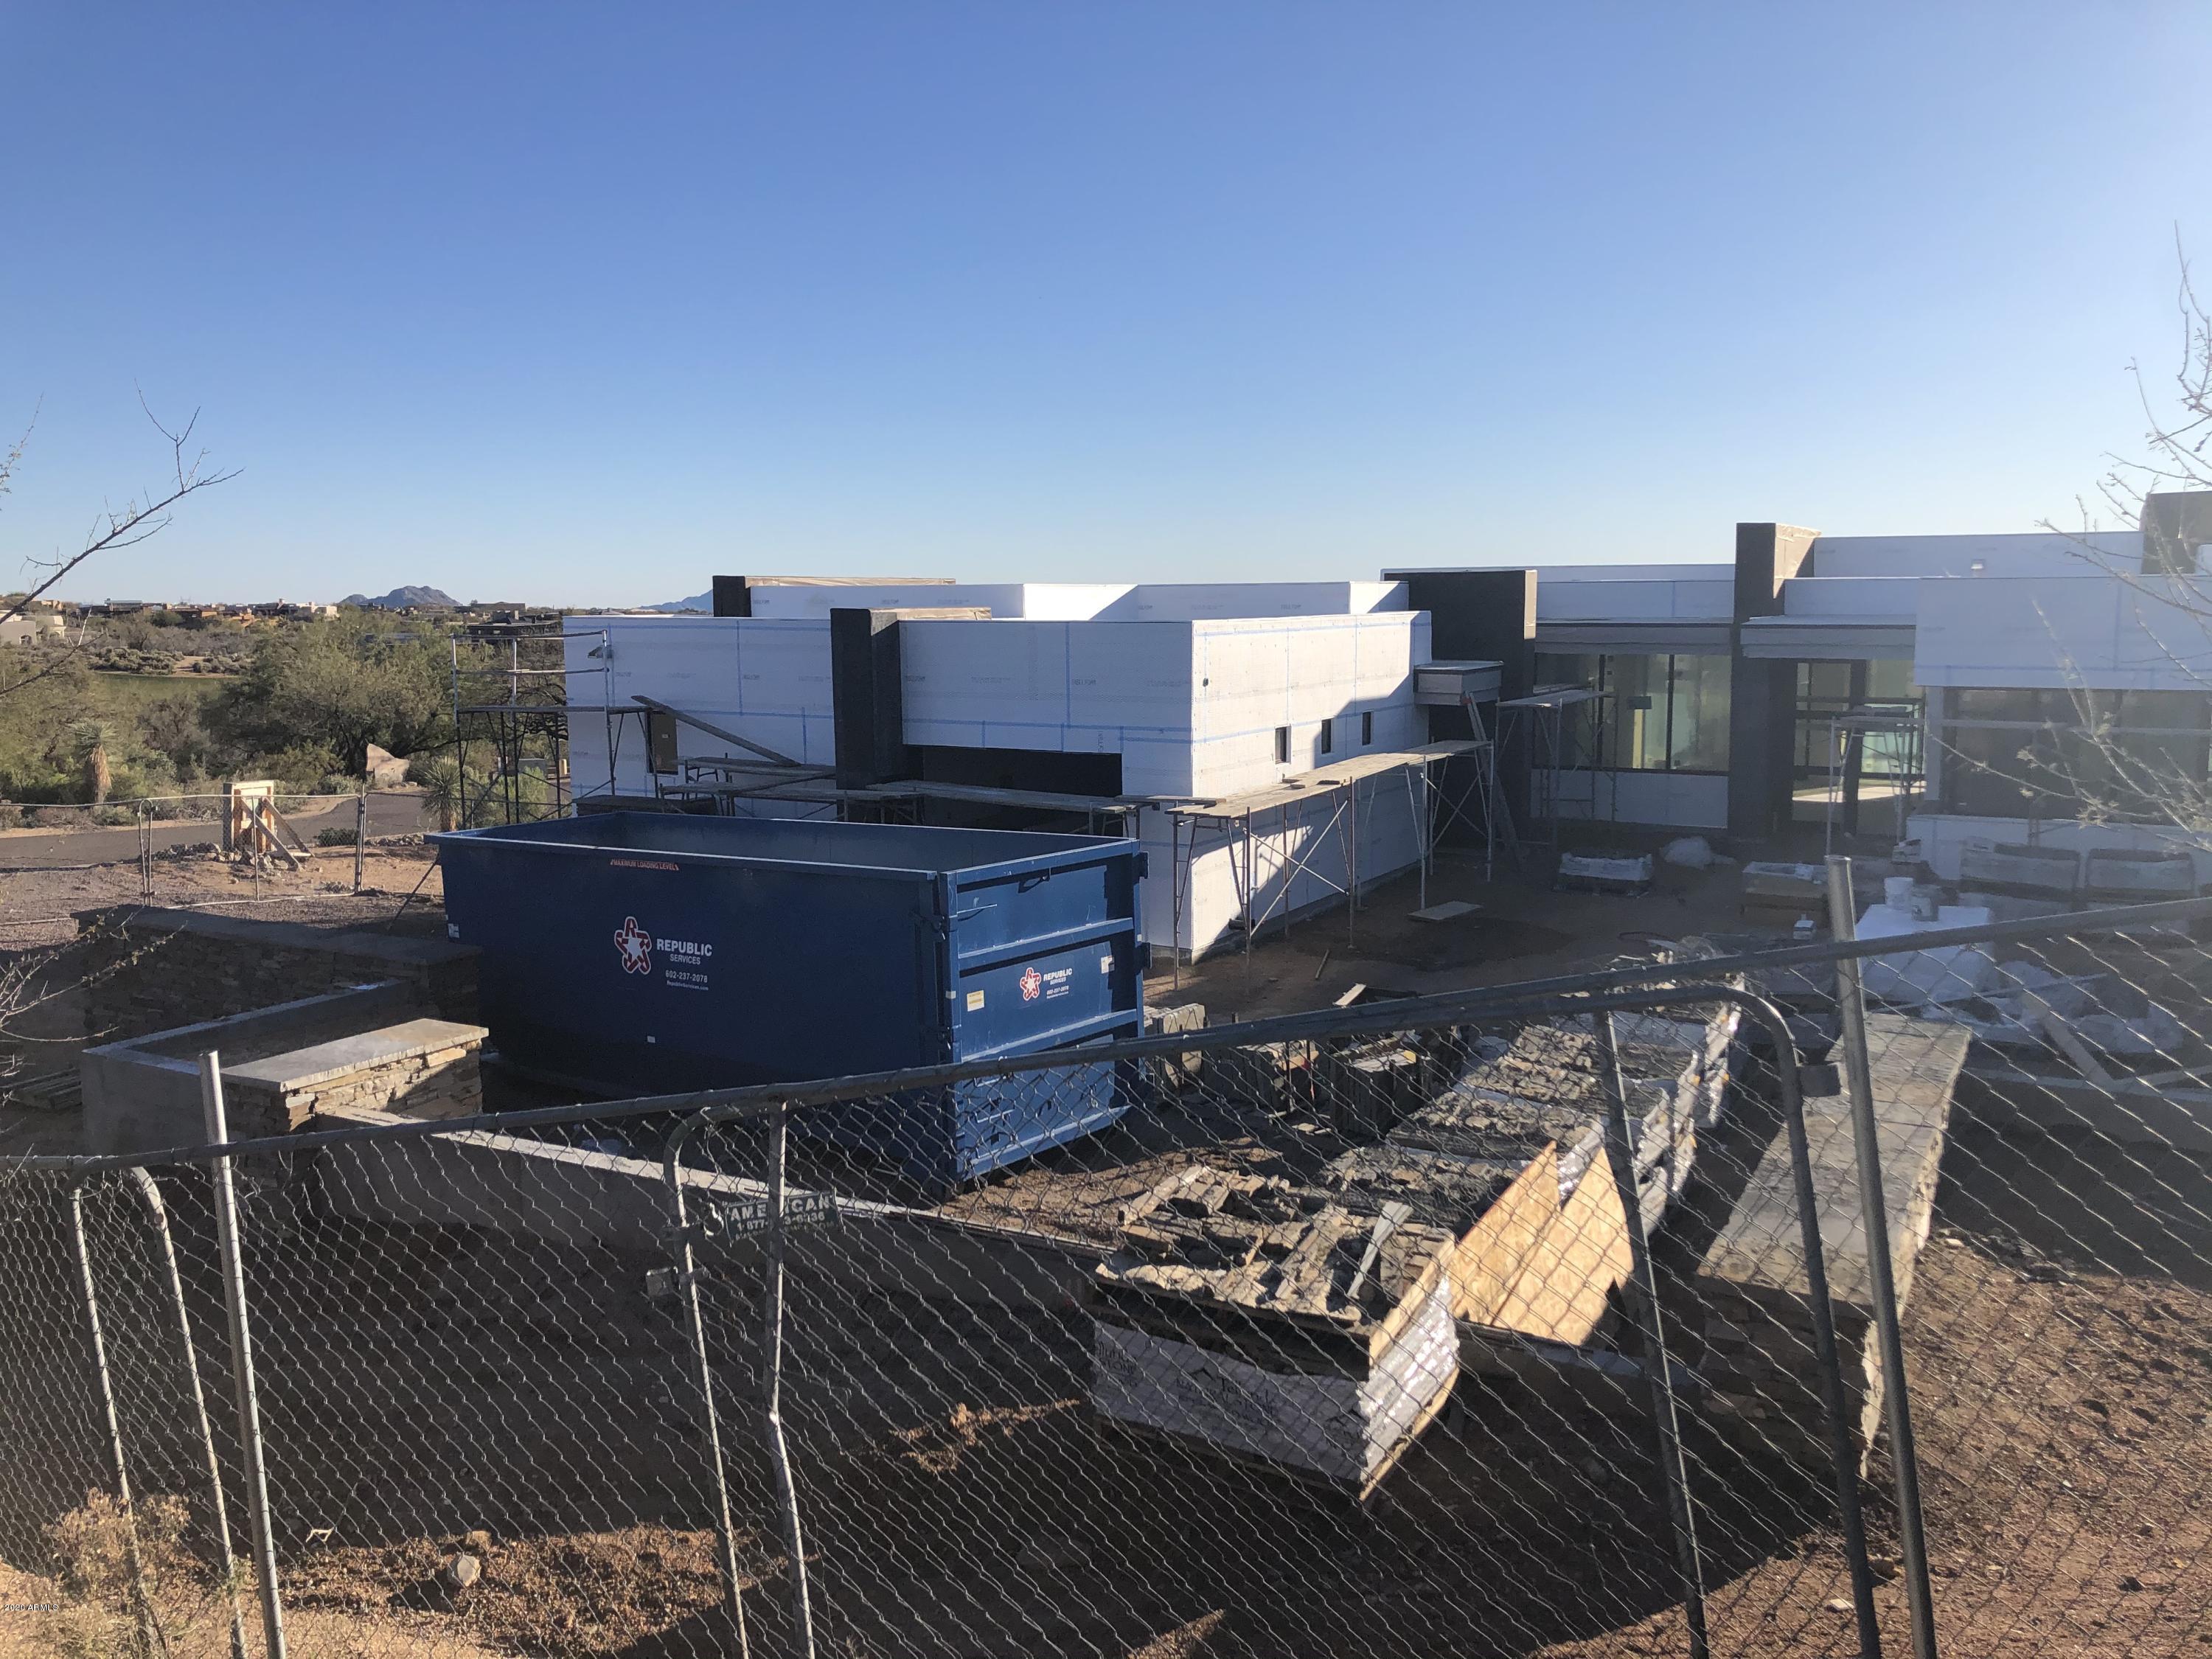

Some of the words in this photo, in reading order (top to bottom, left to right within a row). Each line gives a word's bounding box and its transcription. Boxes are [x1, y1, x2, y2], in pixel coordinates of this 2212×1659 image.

[637, 861, 659, 869] LOADING
[656, 938, 712, 956] REPUBLIC
[669, 953, 701, 965] SERVICES
[665, 970, 708, 983] 602-237-2078
[1043, 967, 1073, 981] REPUBLIC
[731, 1195, 830, 1222] AMEICAN
